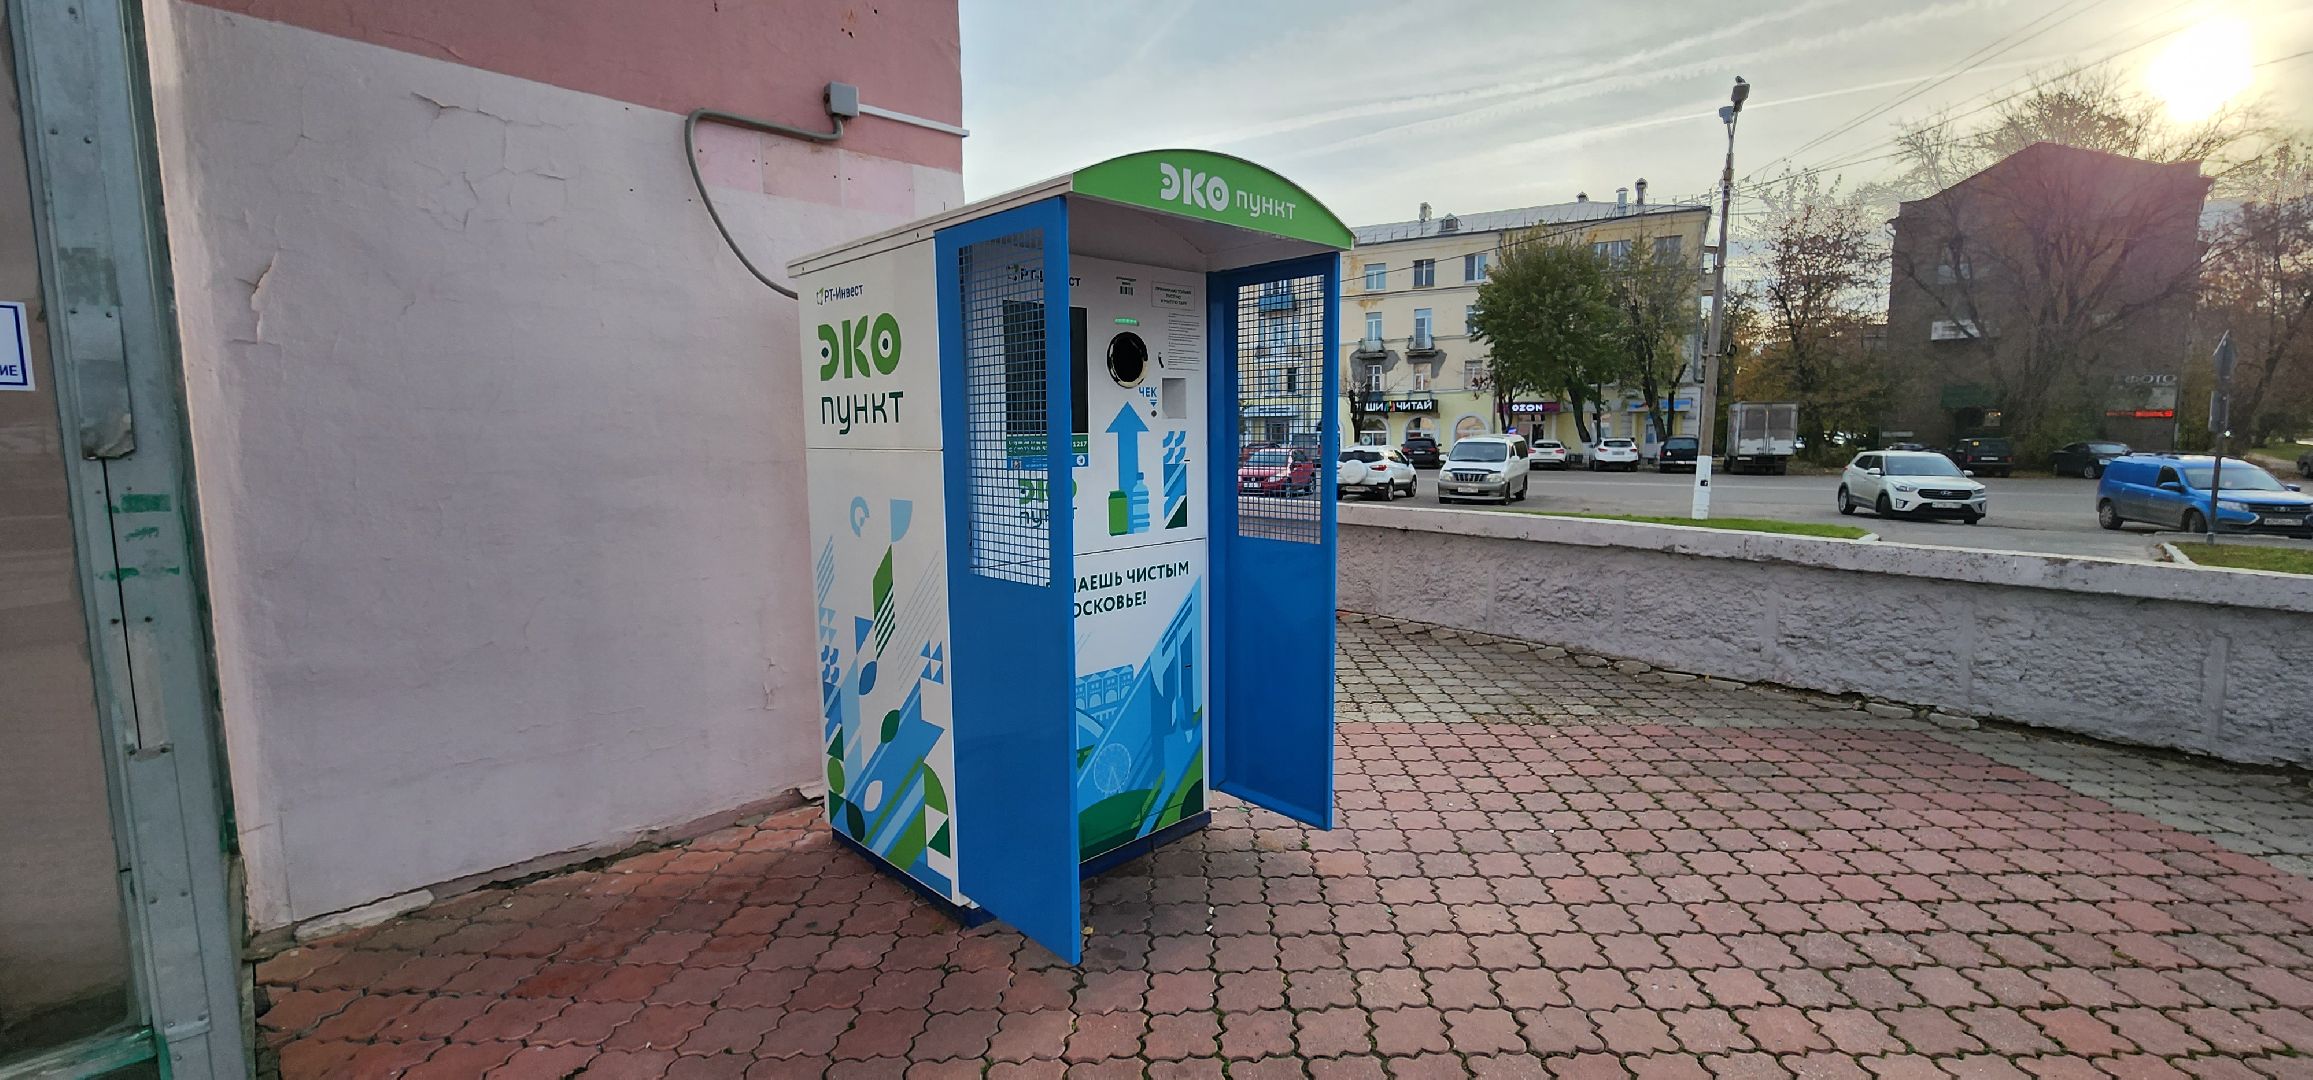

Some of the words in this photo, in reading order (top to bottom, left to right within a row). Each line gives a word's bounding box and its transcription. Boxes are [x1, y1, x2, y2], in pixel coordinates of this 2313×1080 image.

[1160, 163, 1230, 212] ЭКО
[1236, 190, 1297, 220] пункт
[824, 284, 864, 303] РТ-Инвест
[817, 312, 902, 382] ЭКО
[1138, 386, 1158, 398] ЧЕК
[1396, 399, 1433, 411] ЧИТАЙ
[821, 391, 904, 435] пункт
[1511, 403, 1543, 412] OZON
[1073, 571, 1123, 594] АЕШЬ
[1126, 560, 1190, 584] ЧИСТЫМ
